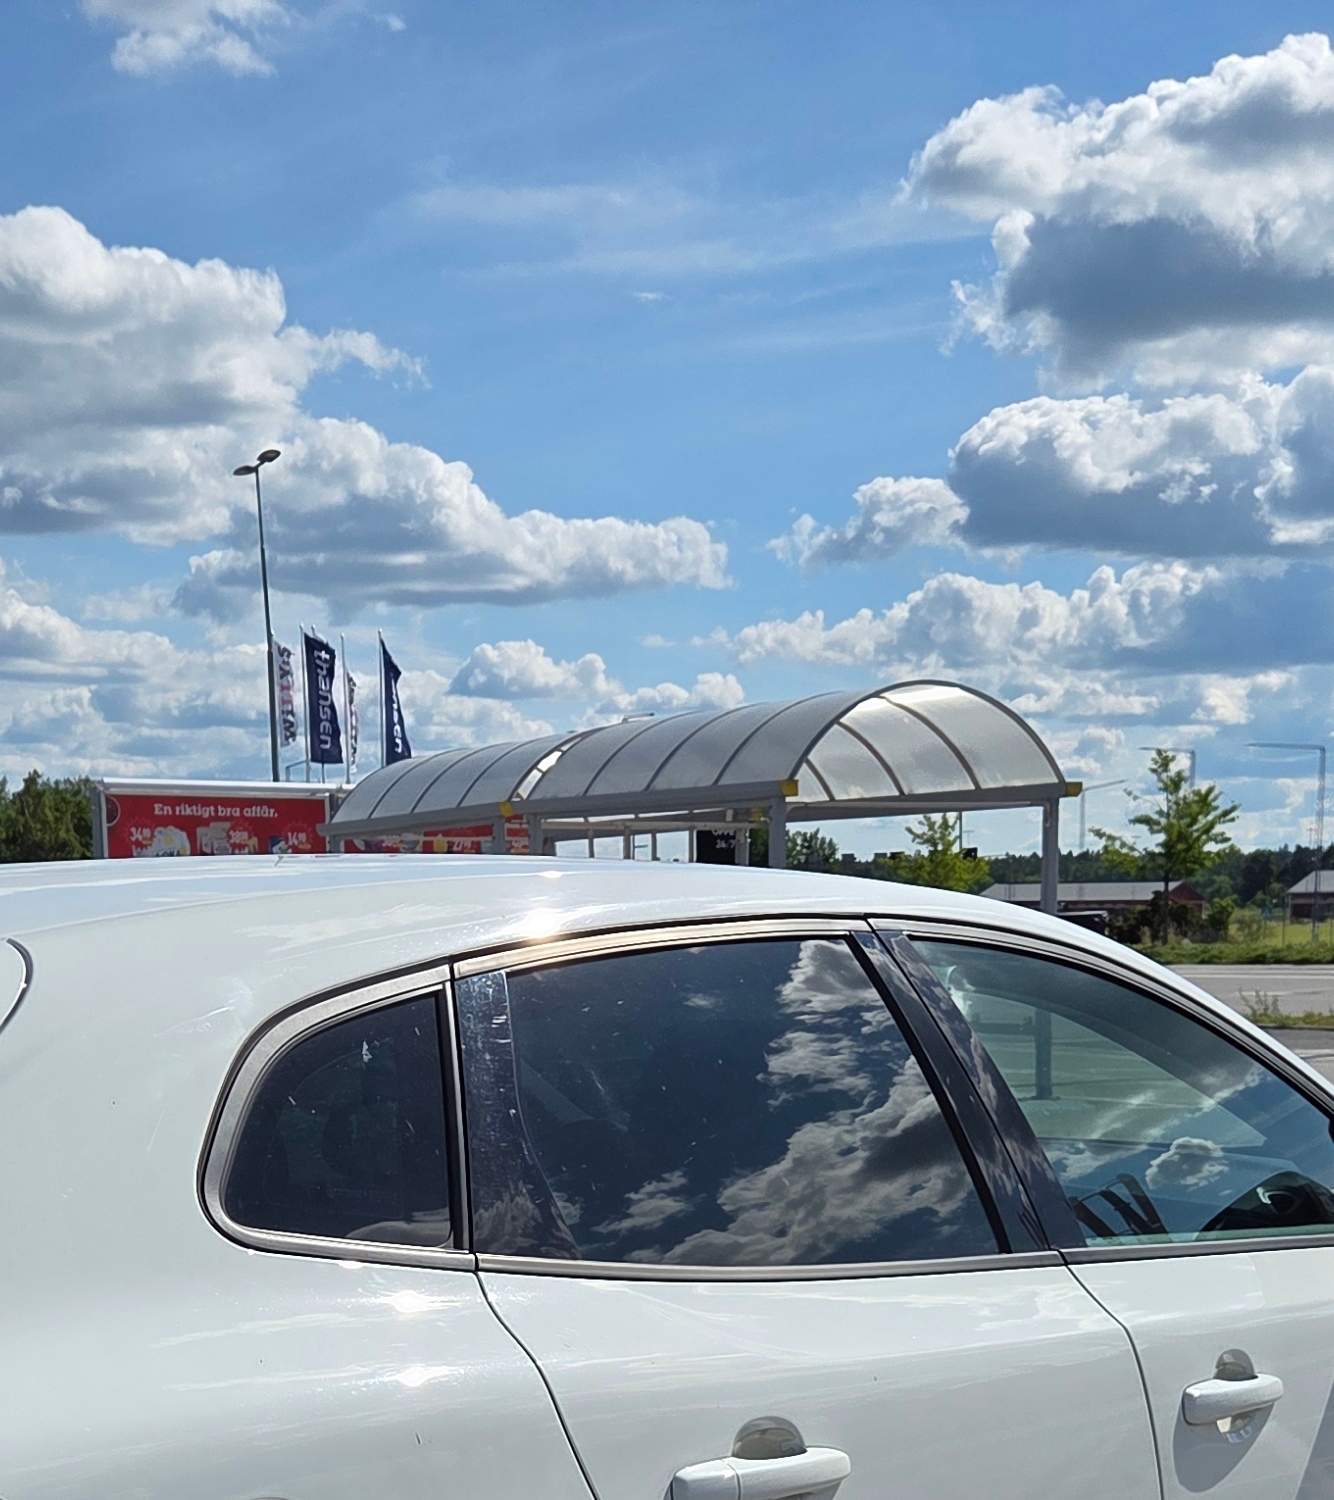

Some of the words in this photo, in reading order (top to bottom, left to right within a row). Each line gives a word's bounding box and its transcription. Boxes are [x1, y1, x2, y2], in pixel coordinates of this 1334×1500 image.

[313, 650, 333, 750] thansen
[153, 803, 173, 816] En
[175, 802, 215, 819] riktigt
[217, 804, 241, 818] bra
